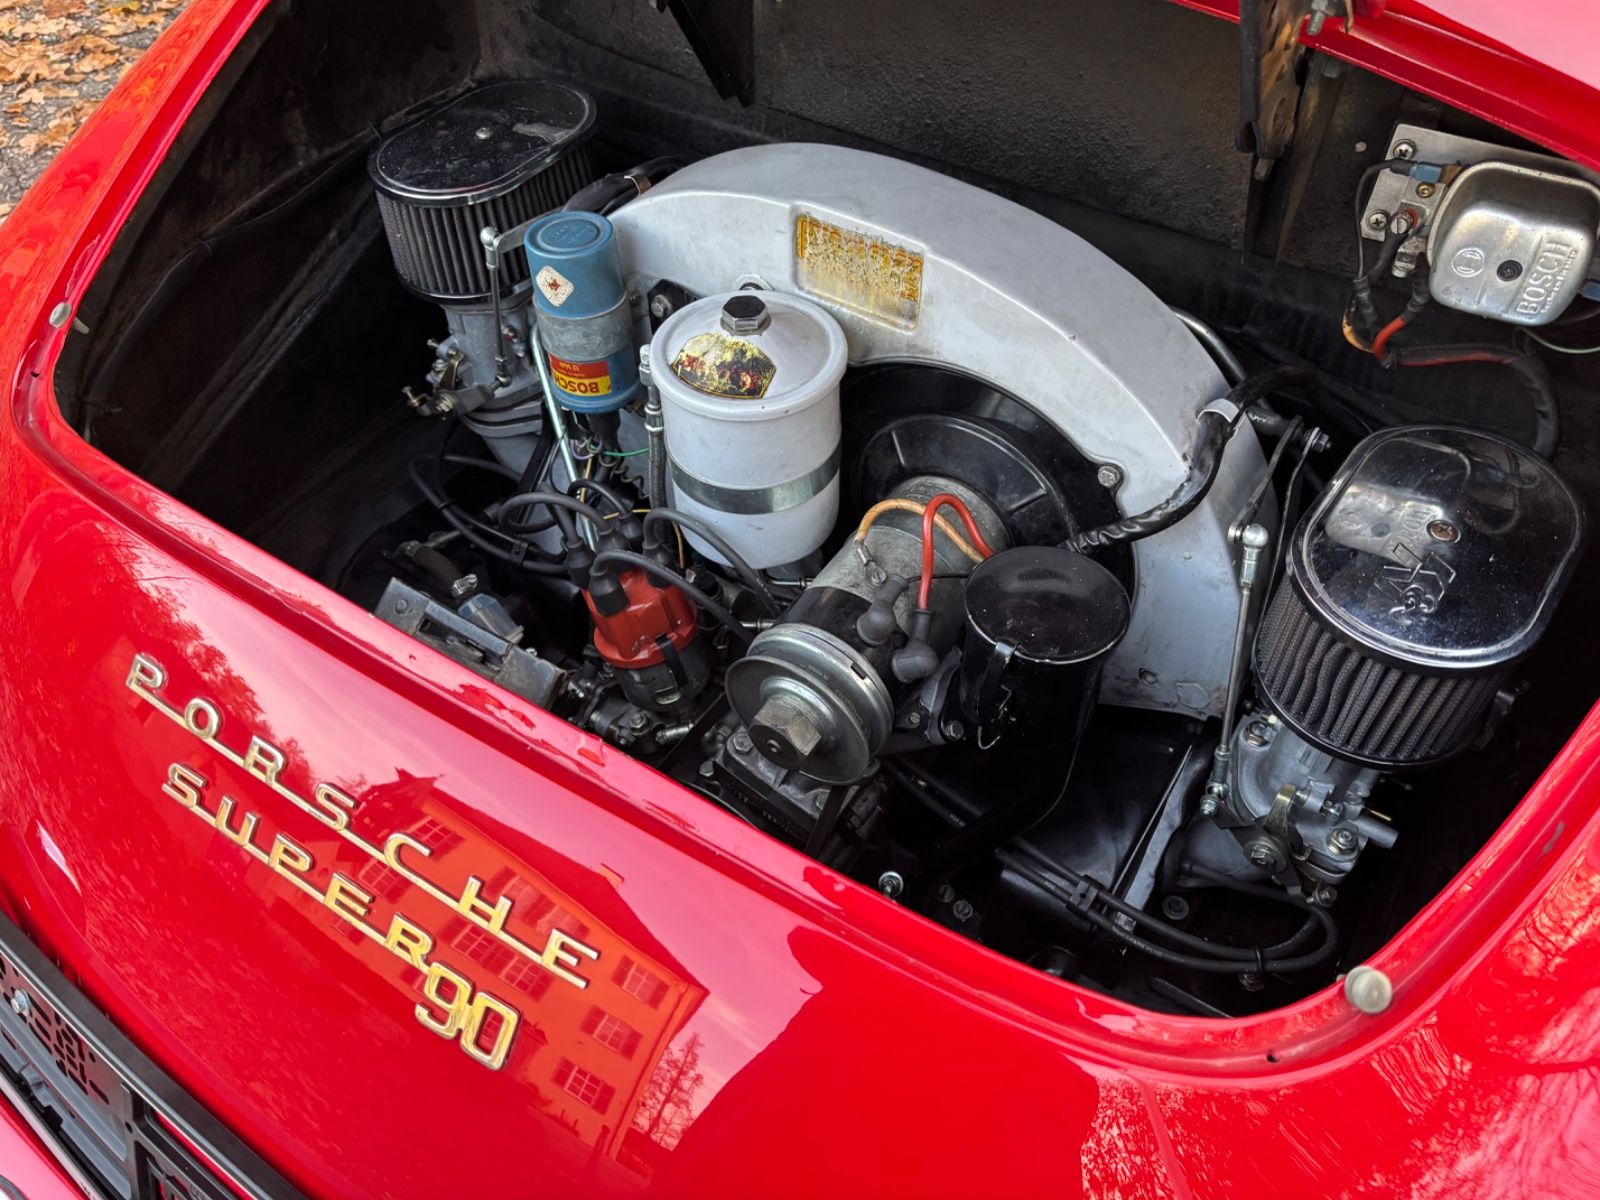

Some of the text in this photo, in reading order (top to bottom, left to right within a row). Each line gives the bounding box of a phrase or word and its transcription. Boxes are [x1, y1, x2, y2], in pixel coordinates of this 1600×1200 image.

[1516, 240, 1576, 316] BOSCH
[126, 652, 600, 989] PORSCHE
[161, 762, 434, 970] SUPER
[415, 961, 521, 1070] 90
